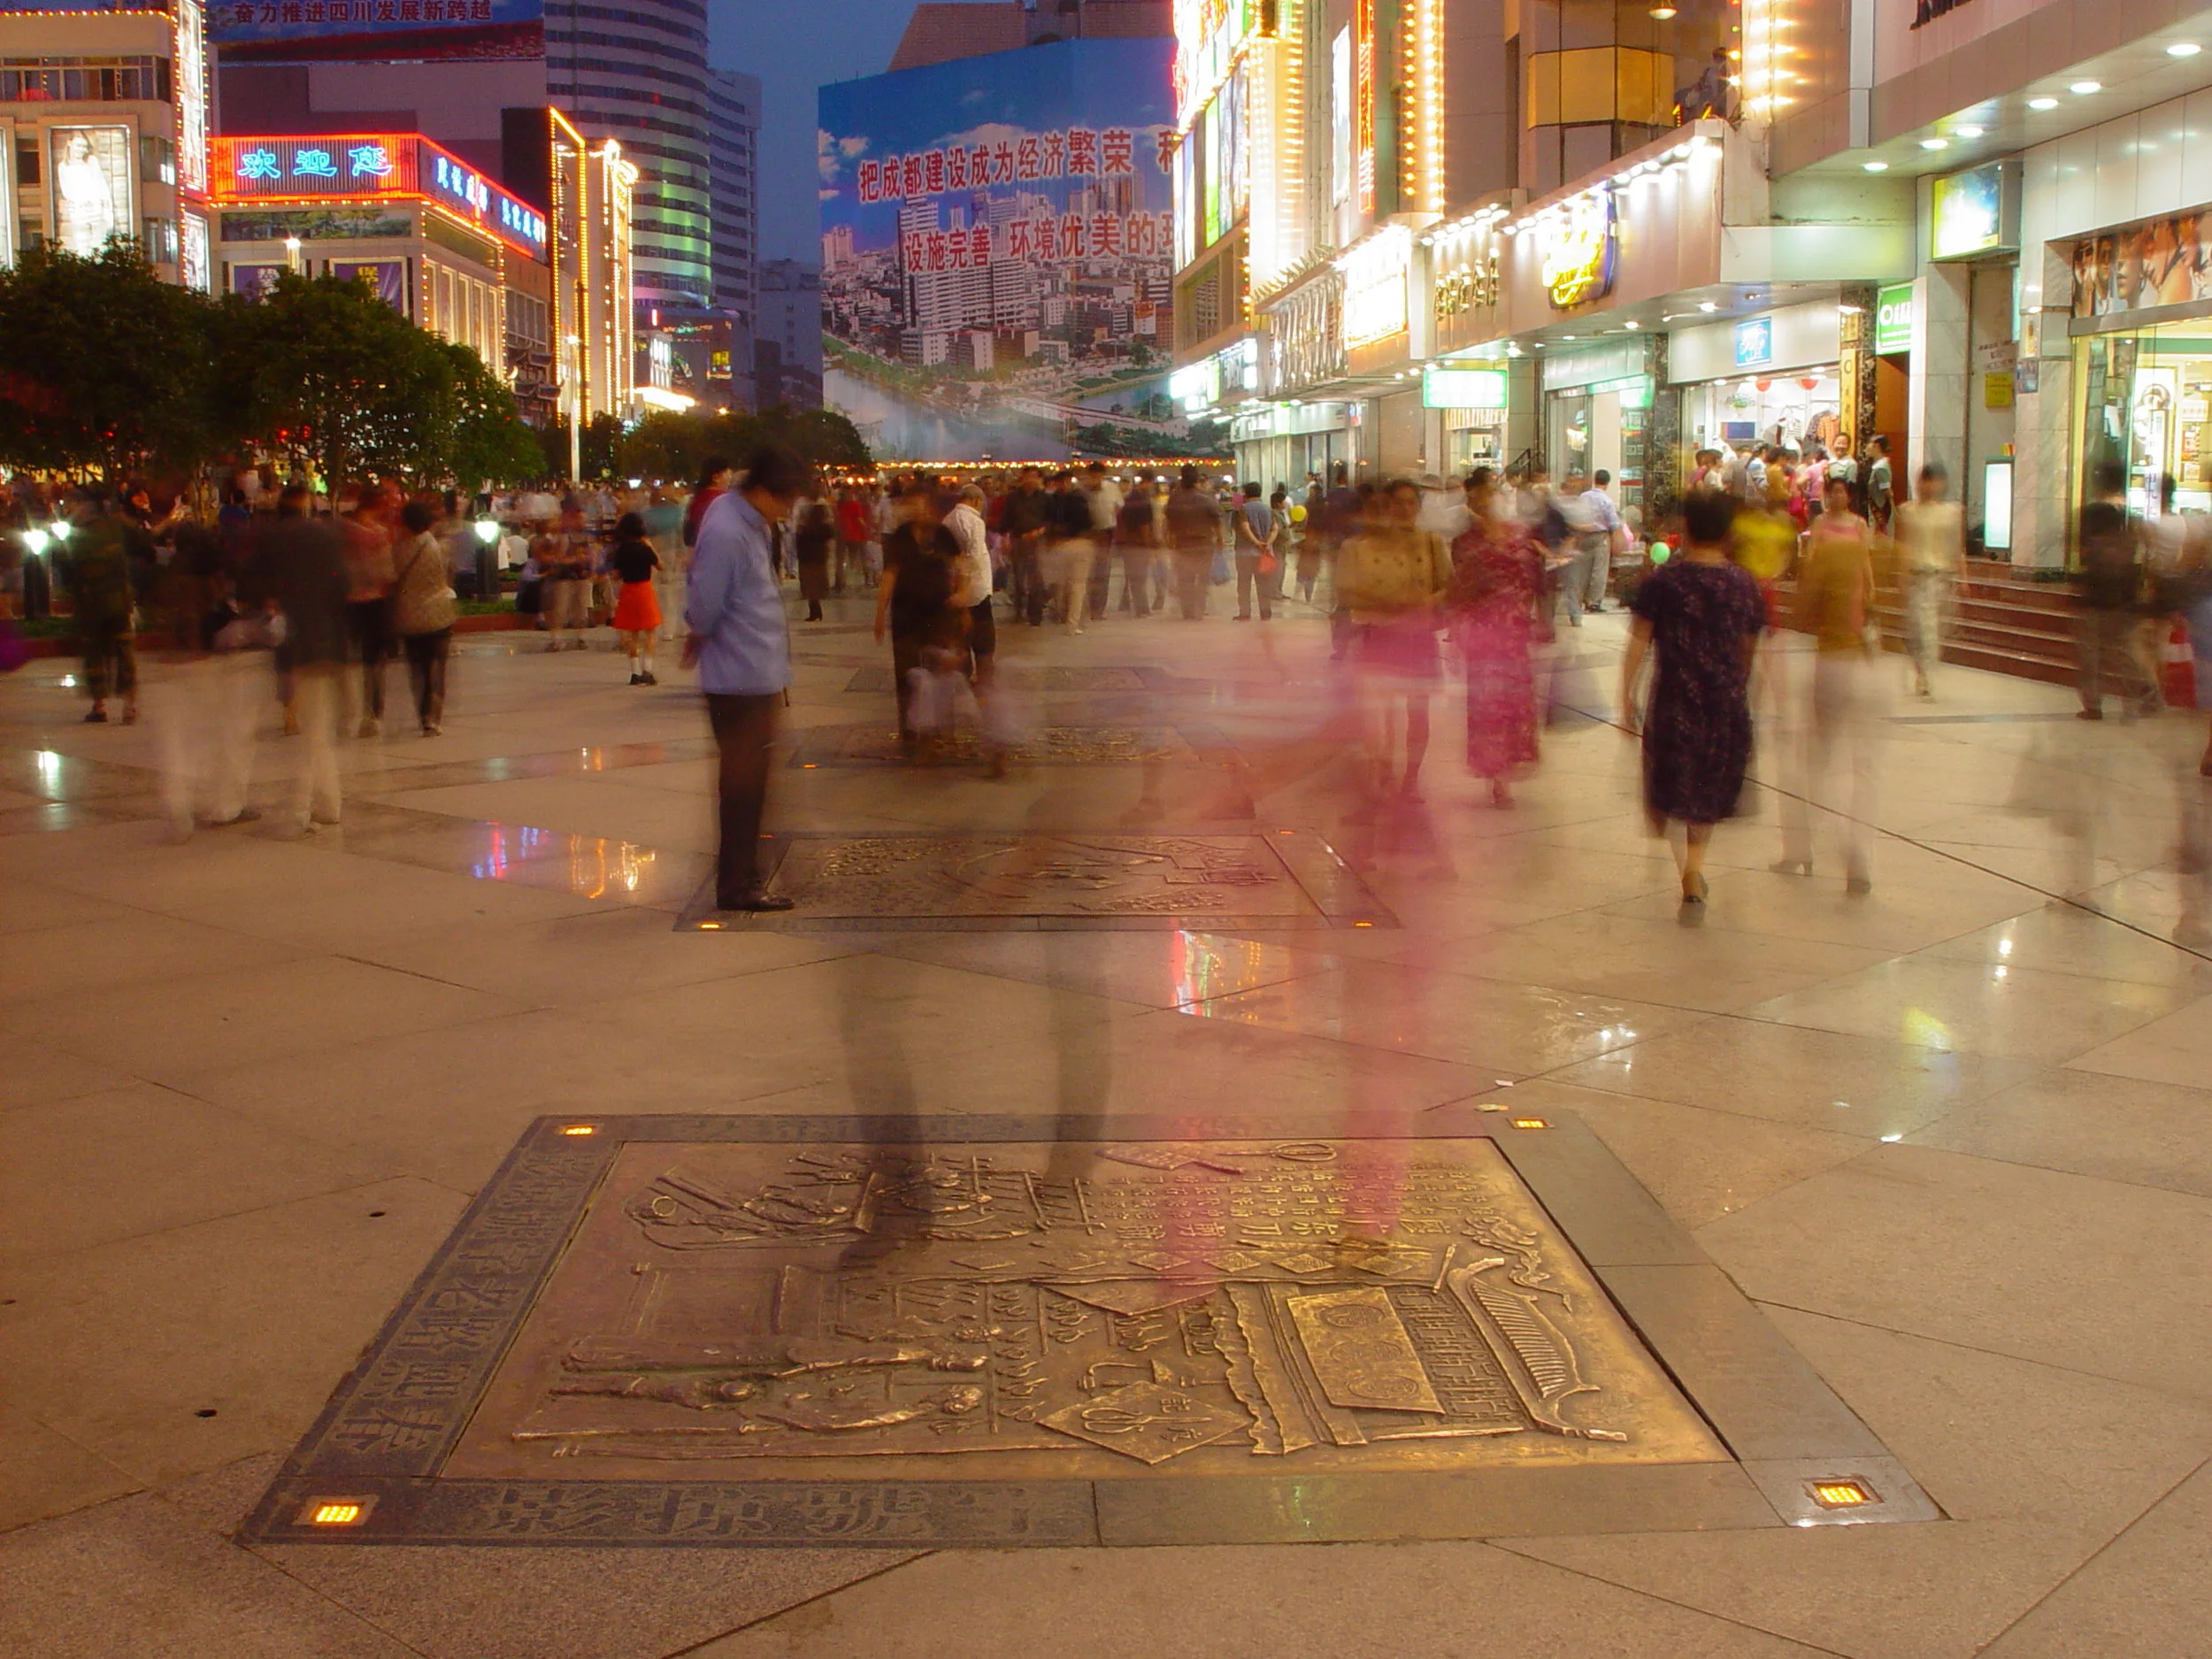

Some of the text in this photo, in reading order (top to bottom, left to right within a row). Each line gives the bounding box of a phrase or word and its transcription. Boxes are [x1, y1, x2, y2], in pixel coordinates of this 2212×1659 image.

[234, 1, 492, 23] 奋力推进四川发展新跨越
[237, 145, 393, 179] 欢迎您
[860, 129, 1133, 202] 把成都建设成为经济繁荣
[905, 224, 991, 273] 设施完善
